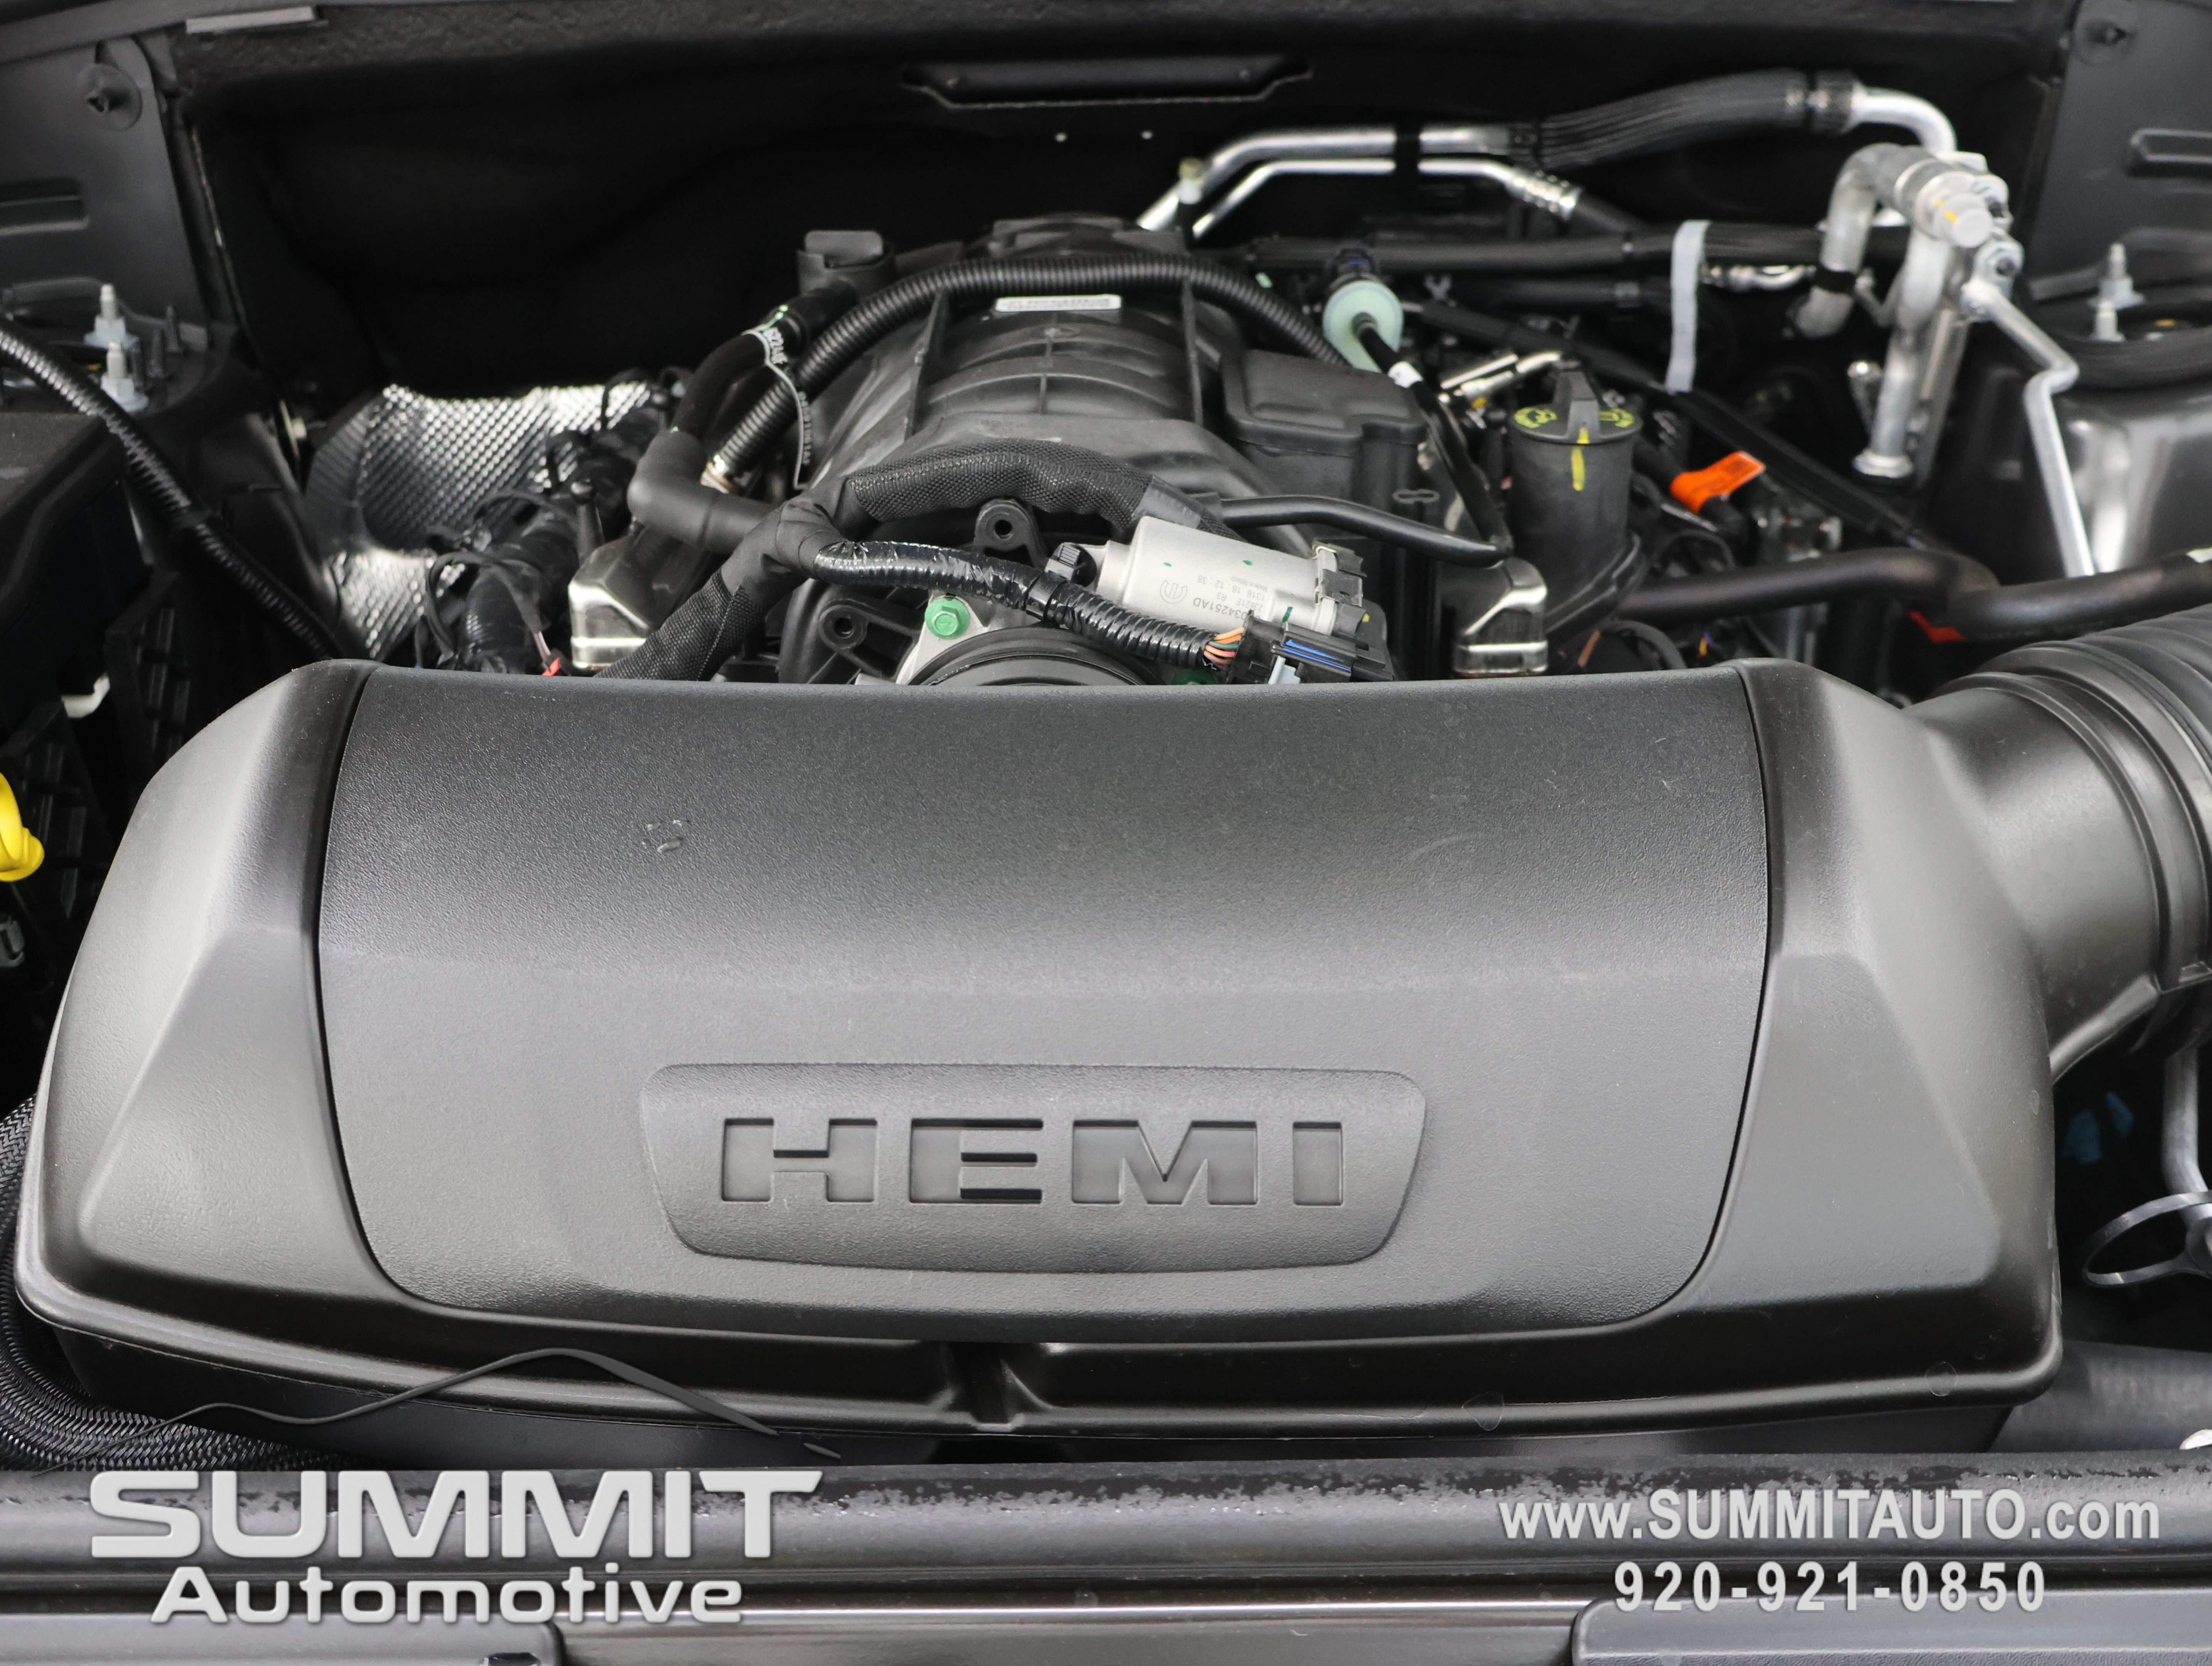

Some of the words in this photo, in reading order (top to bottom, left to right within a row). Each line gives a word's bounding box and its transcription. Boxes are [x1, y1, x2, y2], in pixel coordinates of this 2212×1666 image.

[1216, 592, 1227, 602] R3
[1247, 590, 1265, 602] 1316
[1236, 597, 1264, 612] 23621E
[721, 1118, 1344, 1206] HEMI
